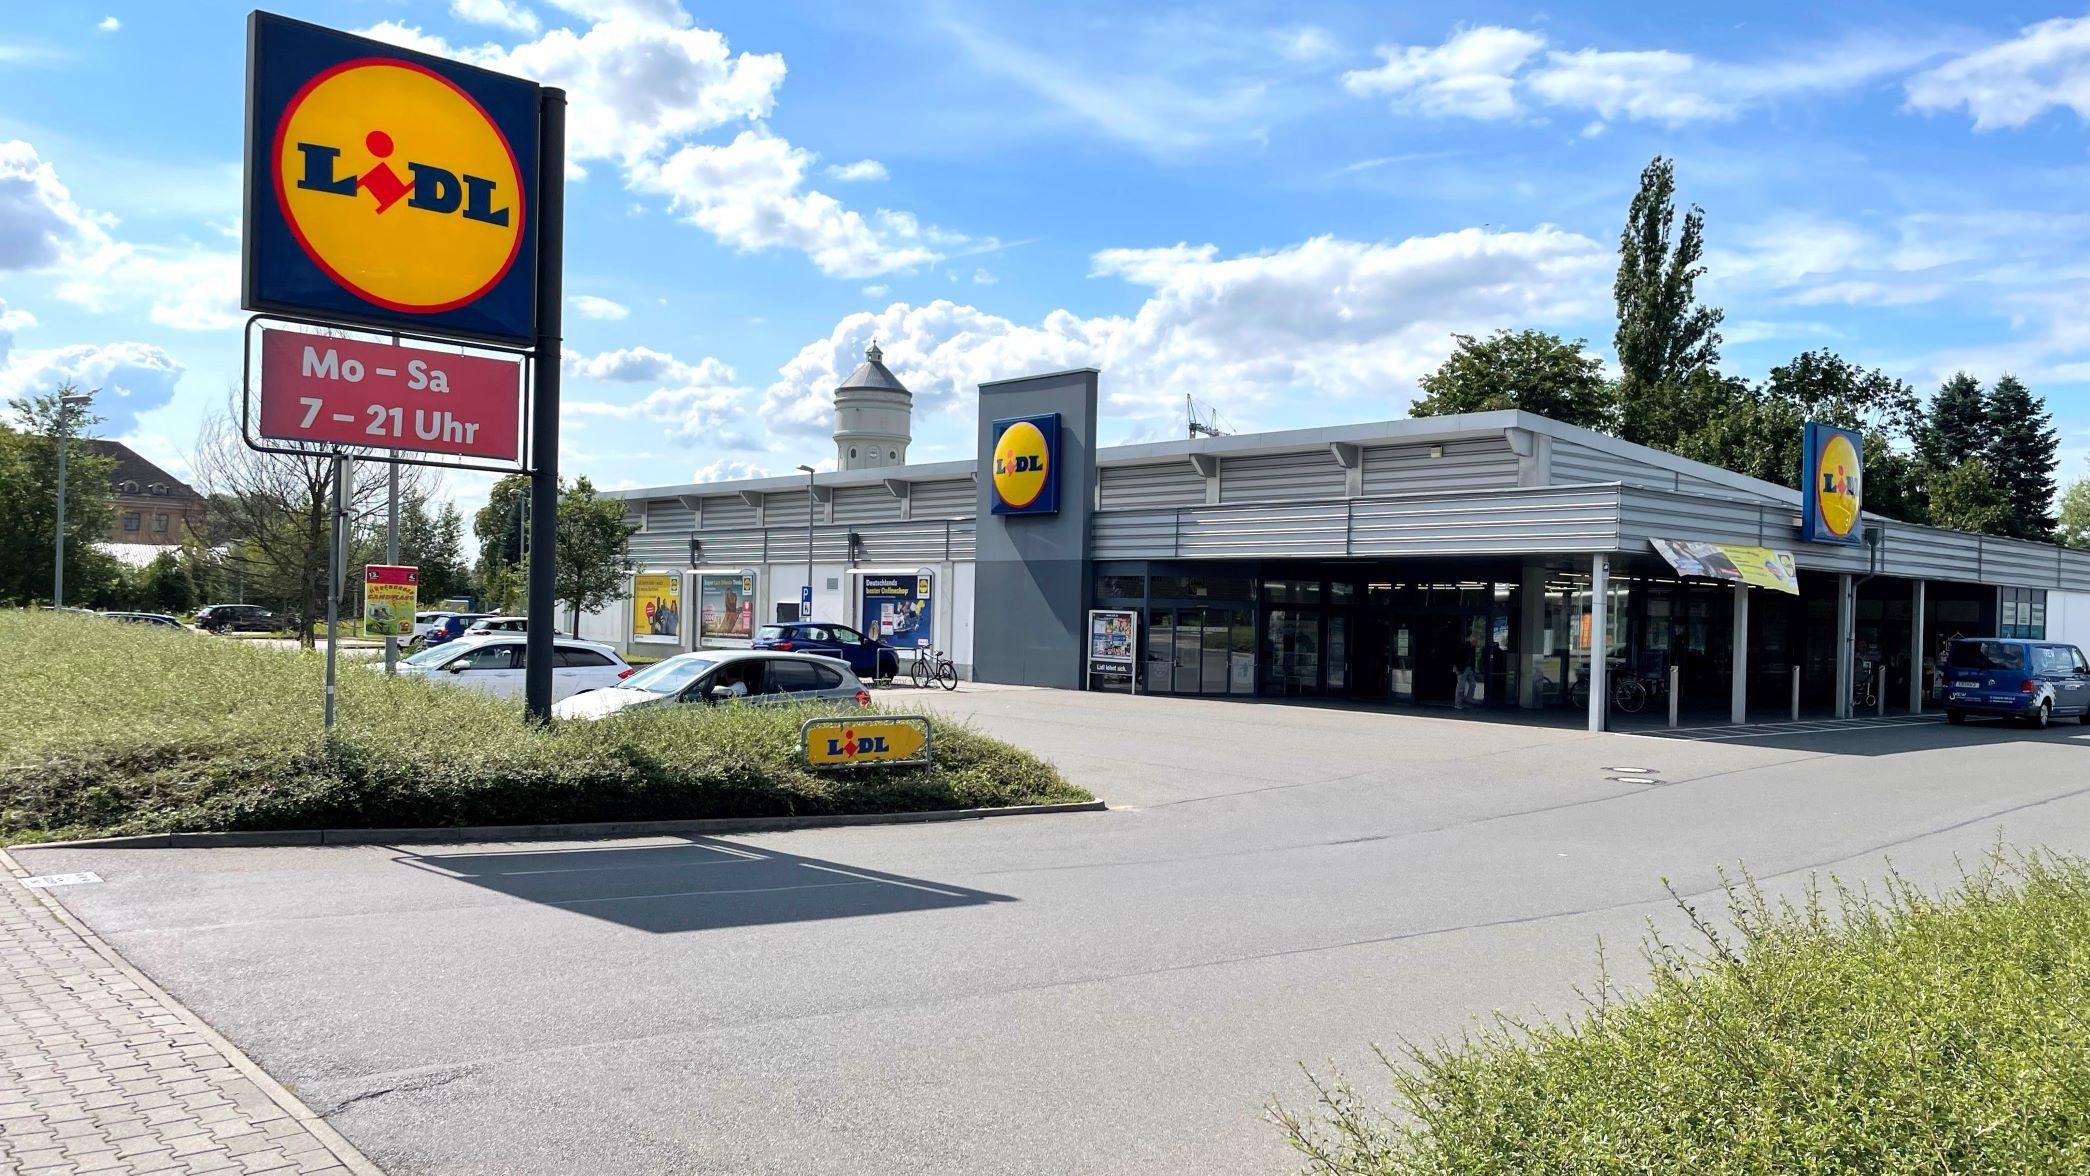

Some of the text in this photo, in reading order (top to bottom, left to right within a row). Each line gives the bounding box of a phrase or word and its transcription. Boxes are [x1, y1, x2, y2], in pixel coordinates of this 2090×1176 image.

[302, 346, 364, 383] Mo
[407, 360, 449, 393] Sa
[299, 397, 323, 429] 7
[366, 403, 403, 437] 21
[415, 410, 480, 444] Uhr
[866, 579, 898, 587] Deutschlands
[803, 588, 809, 600] P
[881, 587, 909, 596] Onlineshop
